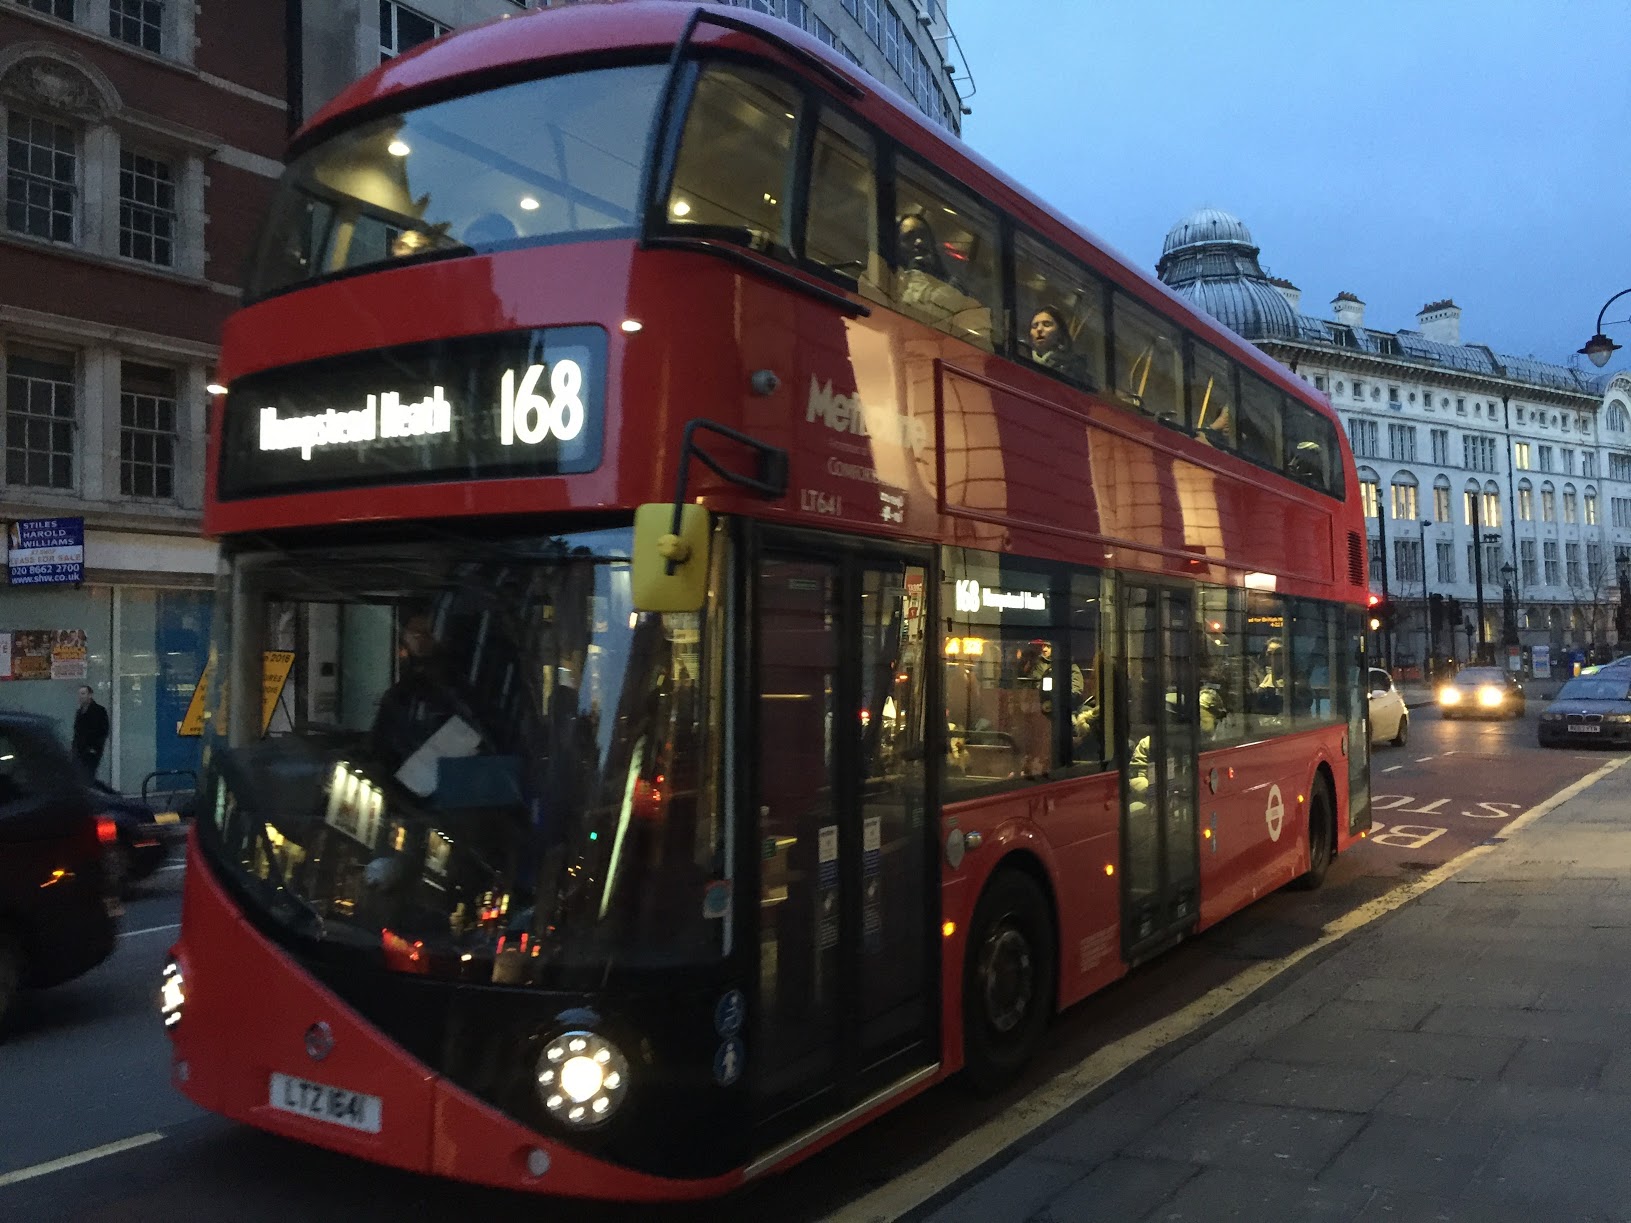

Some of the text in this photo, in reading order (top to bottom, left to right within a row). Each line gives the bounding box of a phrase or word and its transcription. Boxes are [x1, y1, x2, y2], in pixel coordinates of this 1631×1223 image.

[500, 359, 585, 446] 168
[23, 521, 57, 529] STILES
[23, 530, 66, 538] HAROLD
[23, 538, 74, 548] WILLIAMS
[11, 564, 80, 575] 020 8662 2700
[11, 572, 80, 584] www.shw.co.uk
